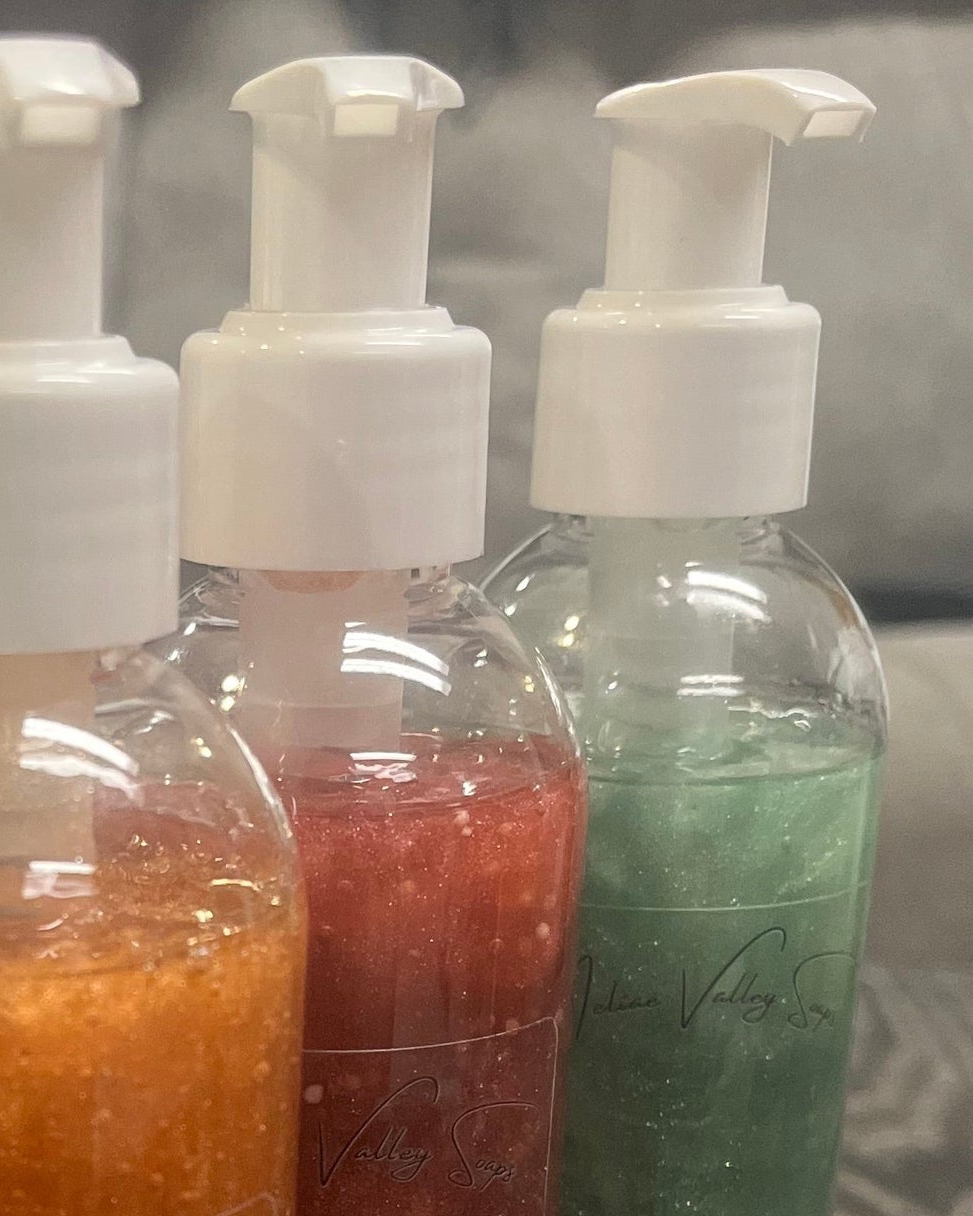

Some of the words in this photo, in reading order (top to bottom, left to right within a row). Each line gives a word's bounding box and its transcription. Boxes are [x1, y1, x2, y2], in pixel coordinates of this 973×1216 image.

[679, 925, 786, 1029] Valley
[317, 1076, 439, 1188] Valley
[447, 1101, 541, 1192] Soaps
